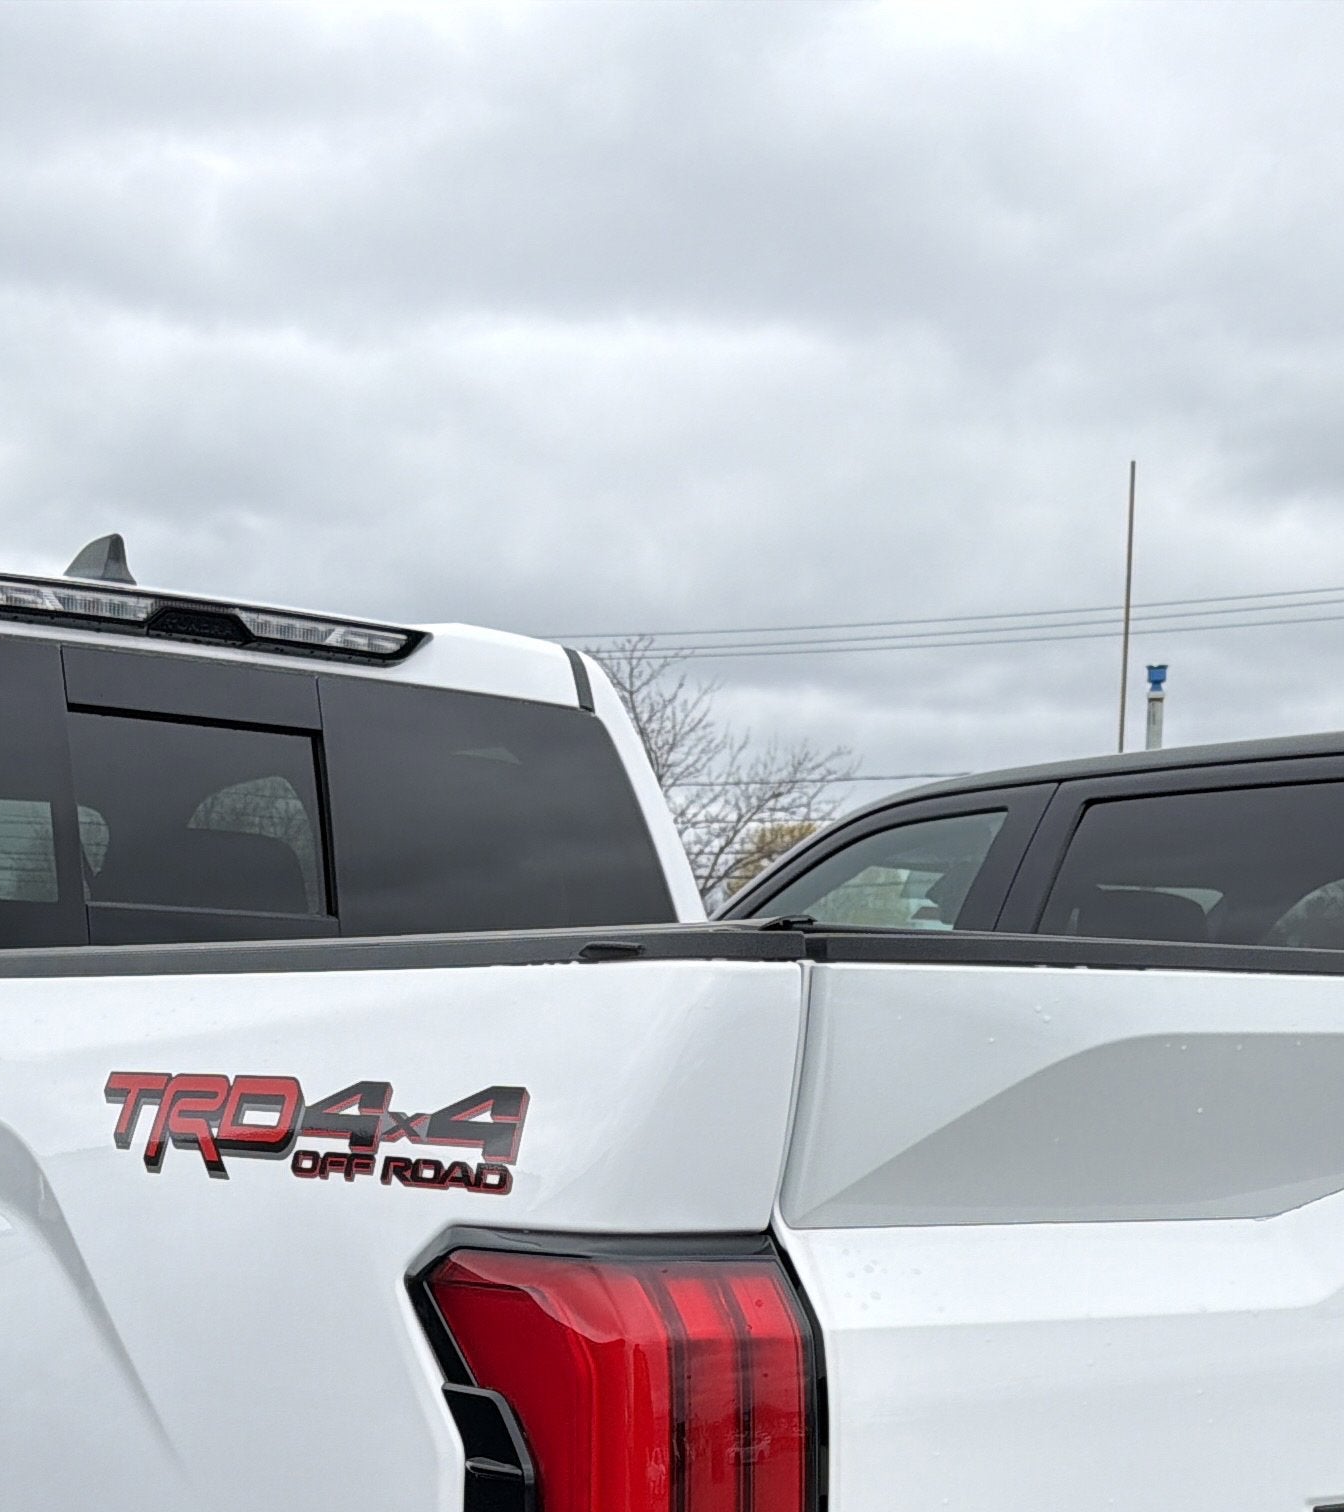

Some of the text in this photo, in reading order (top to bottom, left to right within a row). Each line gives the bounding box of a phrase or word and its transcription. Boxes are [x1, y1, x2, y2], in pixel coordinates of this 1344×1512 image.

[104, 1071, 305, 1180] TRD
[291, 1150, 513, 1194] OFF ROAD
